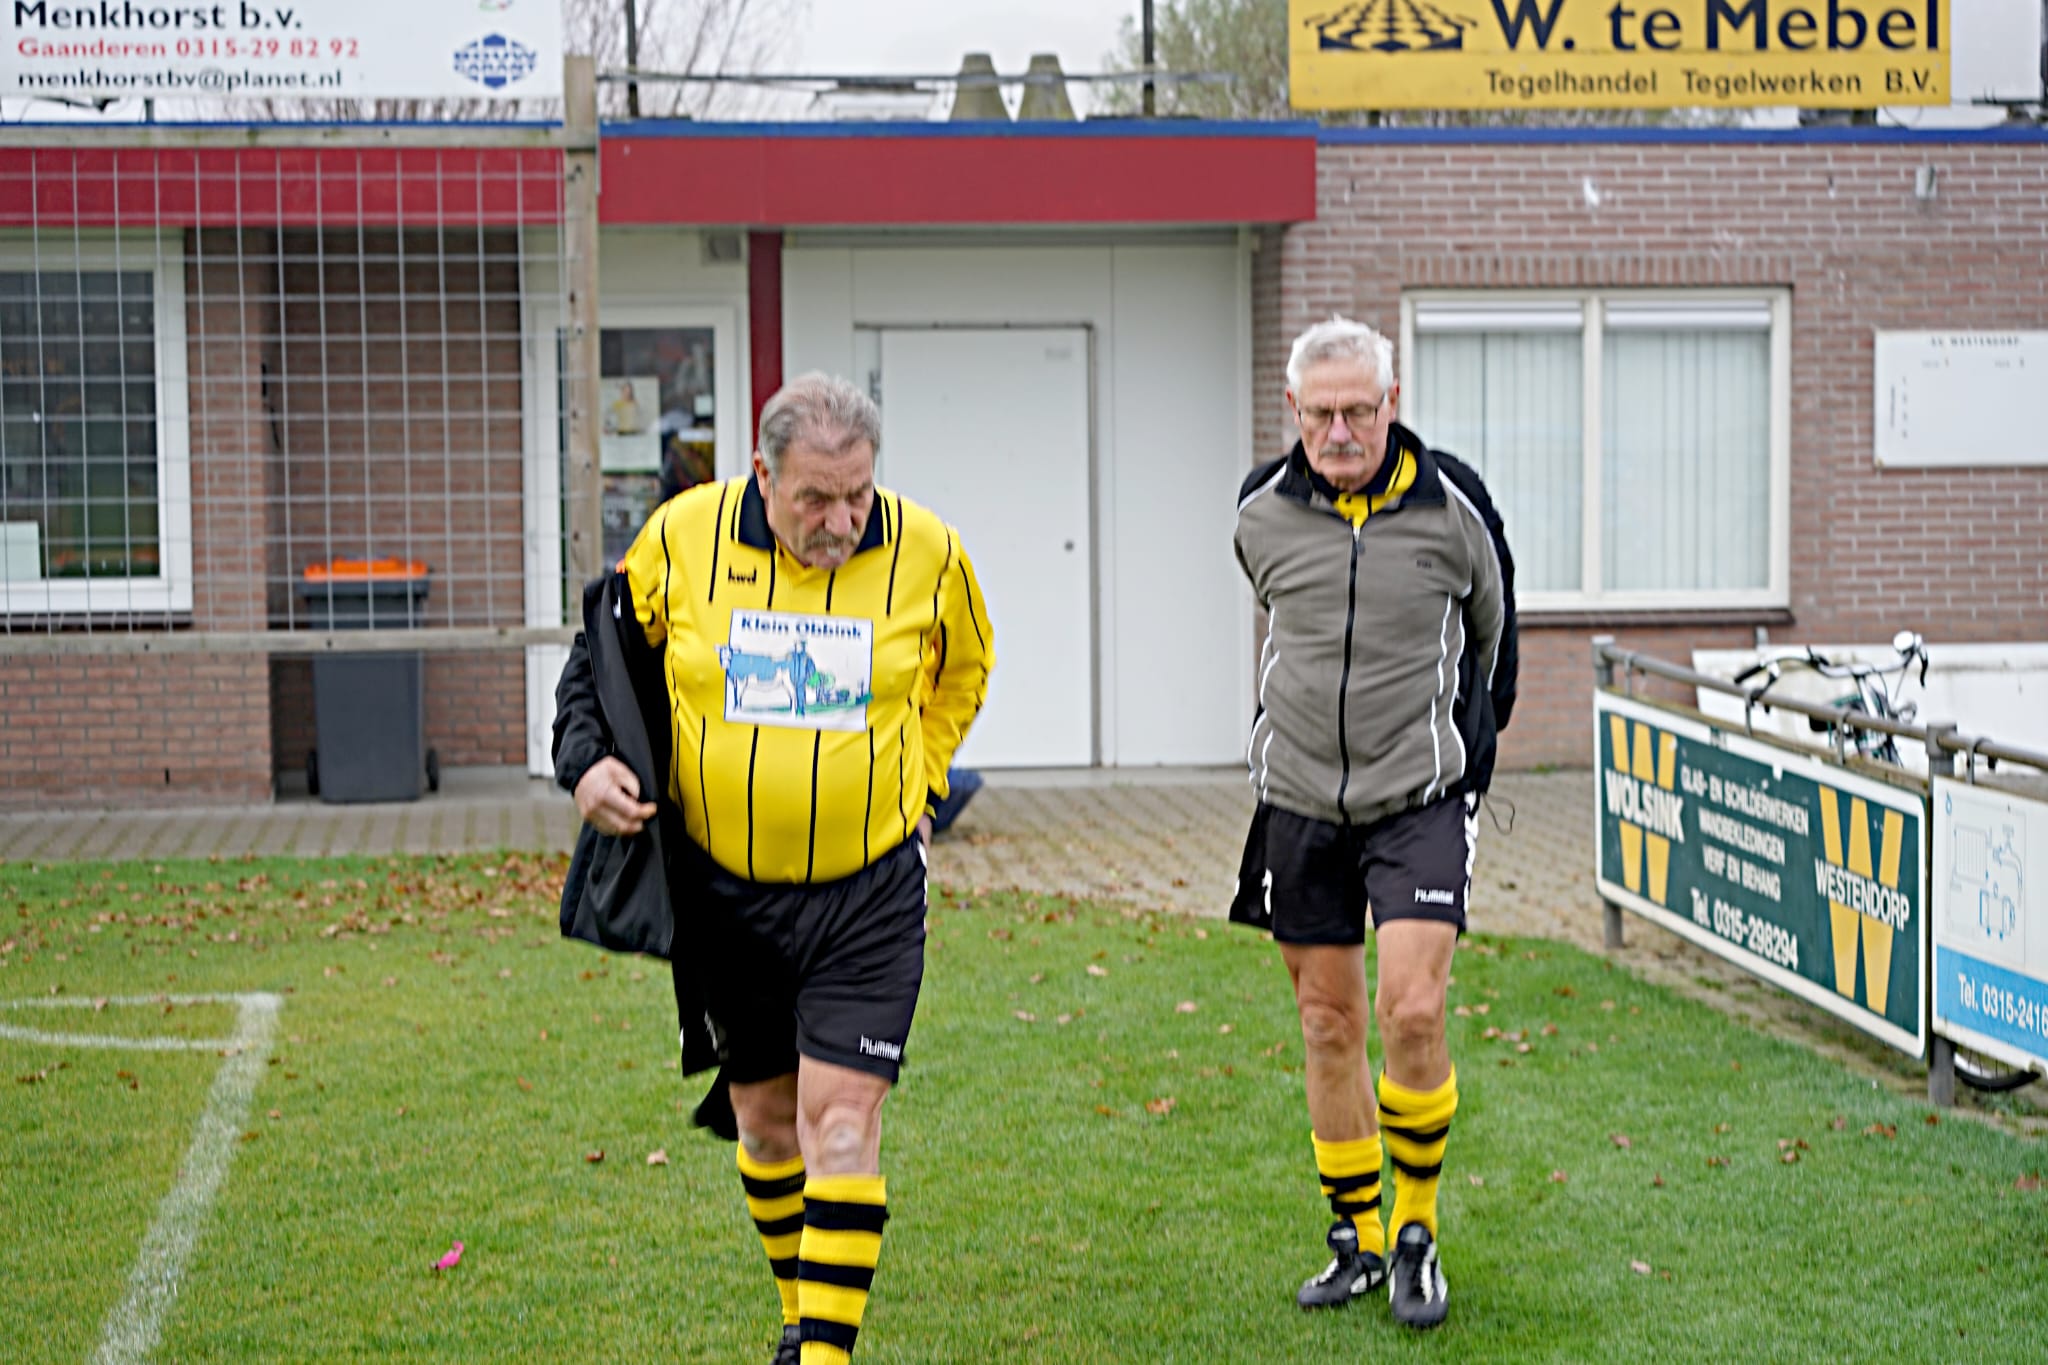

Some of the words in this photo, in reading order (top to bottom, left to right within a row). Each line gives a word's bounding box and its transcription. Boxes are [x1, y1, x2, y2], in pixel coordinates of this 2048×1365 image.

[14, 0, 227, 29] Menkhorst
[240, 0, 302, 29] b.v.
[1490, 0, 1575, 50] W.
[1607, 0, 1682, 50] te
[1704, 0, 1939, 50] Mebel
[18, 37, 167, 58] Gaanderen
[176, 38, 280, 58] 0315-29
[290, 38, 320, 58] 82
[330, 38, 360, 58] 92
[18, 68, 343, 92] menkhorstbv@planet.nl
[1484, 69, 1658, 98] Tegelhandel
[1681, 69, 1862, 97] Tegelwerken
[1886, 70, 1938, 94] B.V.
[741, 616, 789, 634] Klein
[796, 619, 862, 640] Obbink
[1605, 769, 1685, 844] WOLSINK
[1709, 774, 1723, 804] EN
[1724, 780, 1810, 838] SCHILDERWERKEN
[1703, 844, 1726, 877] VERF
[1727, 853, 1740, 884] EN
[1742, 860, 1781, 902] BEHANG
[1815, 857, 1911, 932] WESTENDORP
[1691, 886, 1711, 928] Tel.
[1713, 897, 1799, 971] 0315-298294
[1958, 973, 1979, 1012] Tel.
[1982, 982, 2048, 1039] 0315-2416
